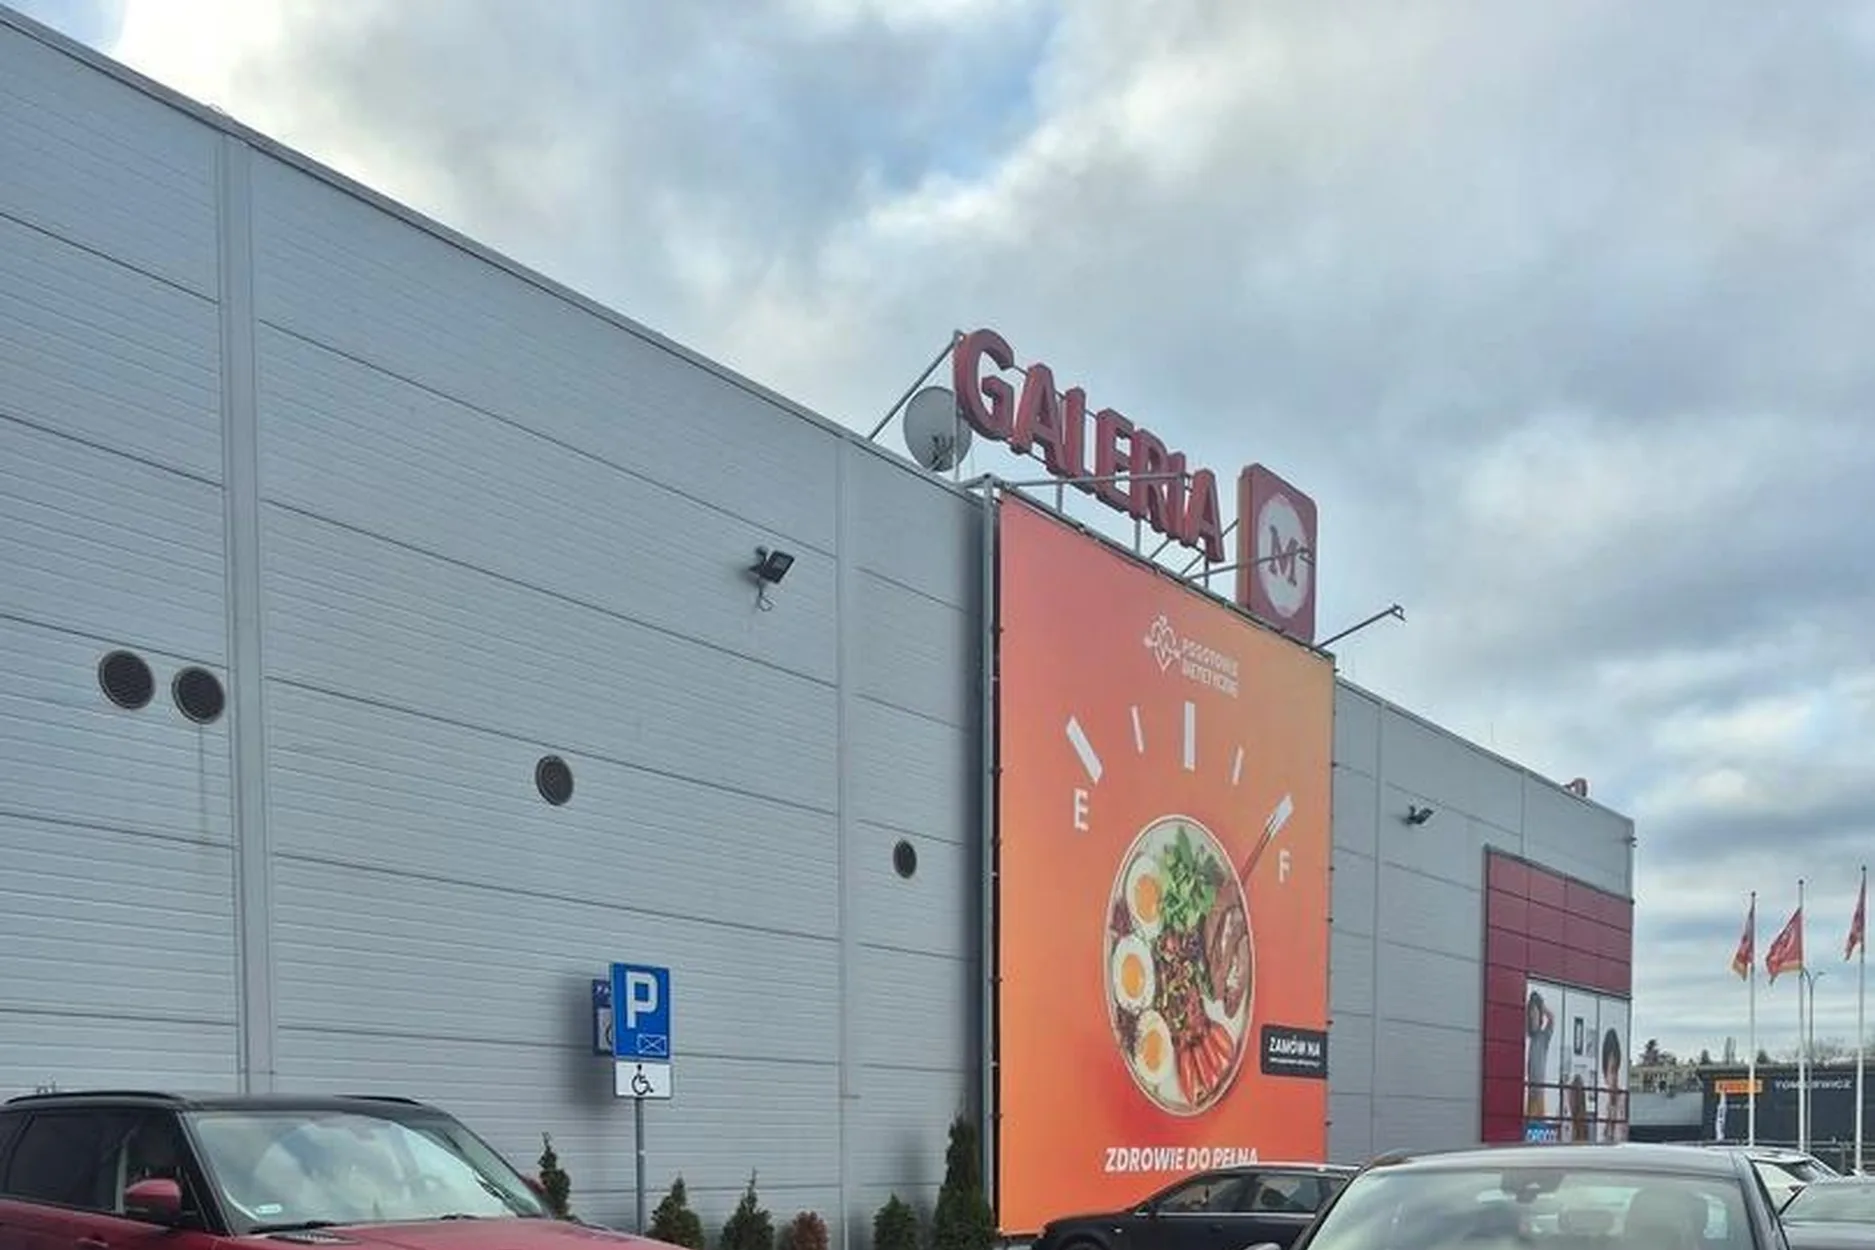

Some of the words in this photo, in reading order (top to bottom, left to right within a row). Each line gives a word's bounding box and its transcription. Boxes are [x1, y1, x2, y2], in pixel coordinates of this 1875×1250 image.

[953, 329, 1225, 562] GALERIA
[1269, 524, 1299, 588] M
[1074, 788, 1089, 832] E
[1279, 850, 1291, 883] F
[626, 970, 658, 1029] P
[1104, 1147, 1185, 1173] ZDROWIE
[1186, 1147, 1211, 1172] DO
